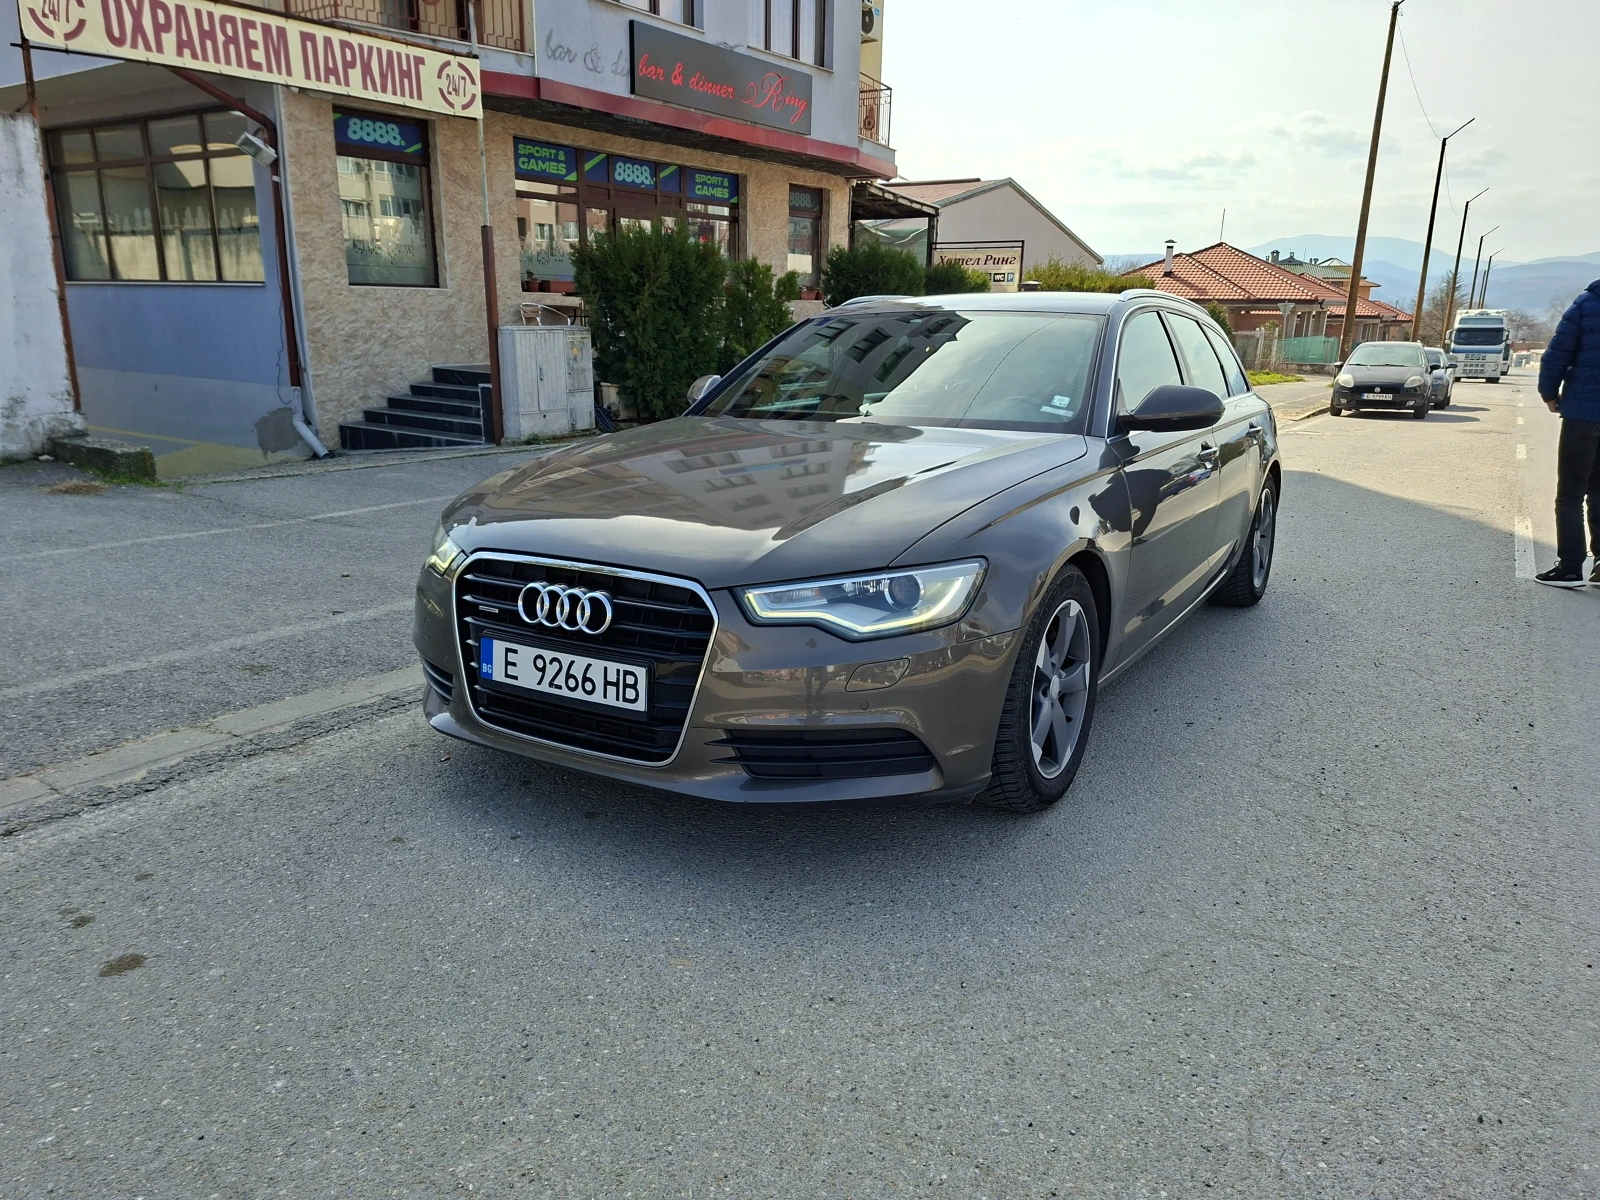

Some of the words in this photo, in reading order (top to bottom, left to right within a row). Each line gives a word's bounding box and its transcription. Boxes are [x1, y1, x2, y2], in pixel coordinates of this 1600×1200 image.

[101, 0, 293, 77] ОХРАНЯЕМ
[299, 30, 426, 101] ПАРКИНГ
[445, 73, 467, 98] 24/7
[638, 54, 666, 81] bar
[671, 62, 684, 86] &
[689, 71, 736, 99] dinner
[740, 72, 809, 124] Ring
[518, 143, 556, 159] SPORT
[558, 151, 566, 161] &
[518, 157, 567, 175] GAMES
[695, 173, 723, 186] SPORT
[723, 178, 729, 187] &
[695, 184, 729, 198] GAMES
[939, 255, 981, 266] Хотел
[983, 254, 1017, 266] Ринг
[1008, 273, 1013, 281] P
[482, 663, 492, 674] BG
[504, 647, 519, 681] E
[533, 653, 596, 696] 9266
[603, 666, 640, 704] HB
